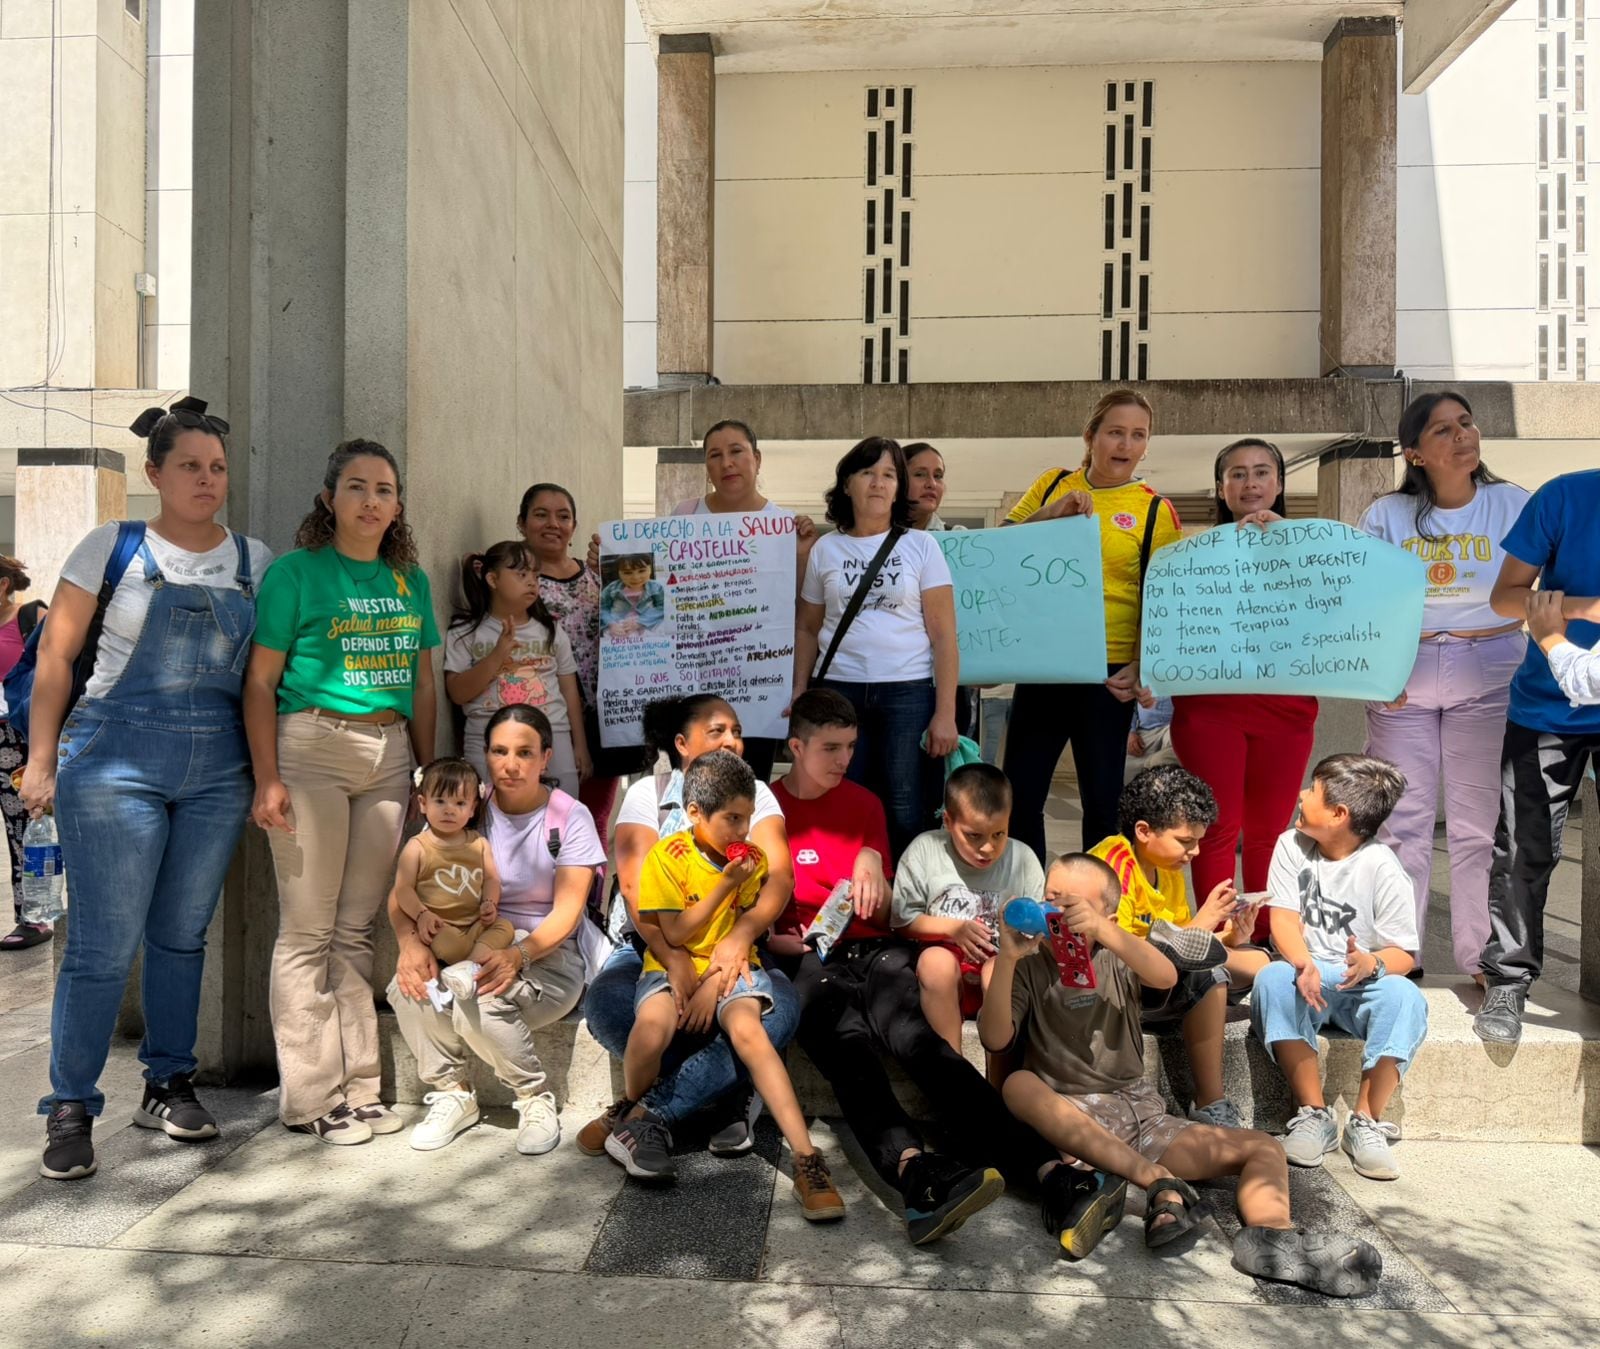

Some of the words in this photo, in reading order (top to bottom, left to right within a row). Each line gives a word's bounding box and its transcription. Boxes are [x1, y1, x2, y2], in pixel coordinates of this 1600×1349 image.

[634, 519, 695, 539] DERECHO
[702, 522, 713, 538] A
[718, 521, 733, 538] LA
[738, 515, 795, 538] SALUD
[651, 542, 662, 554] DE
[843, 558, 858, 569] IN
[861, 555, 902, 570] LVE
[1172, 581, 1185, 596] la
[1239, 580, 1256, 594] de
[1263, 573, 1312, 592] nuestros
[347, 597, 407, 614] NUESTRA
[1148, 605, 1169, 619] NO
[1176, 602, 1223, 618] tienen
[327, 613, 373, 639] Salud
[1176, 620, 1221, 640] tienen
[1230, 617, 1290, 635] Terapias
[341, 637, 391, 652] DEPENDE
[394, 635, 409, 650] DE
[344, 650, 410, 670] GARANTÍA
[746, 644, 794, 662] ATENCIÓN
[343, 671, 368, 686] SUS
[635, 673, 645, 685] LO
[649, 671, 669, 685] QUE
[679, 664, 741, 682] SOLICITAMOS
[1256, 662, 1277, 681] NO
